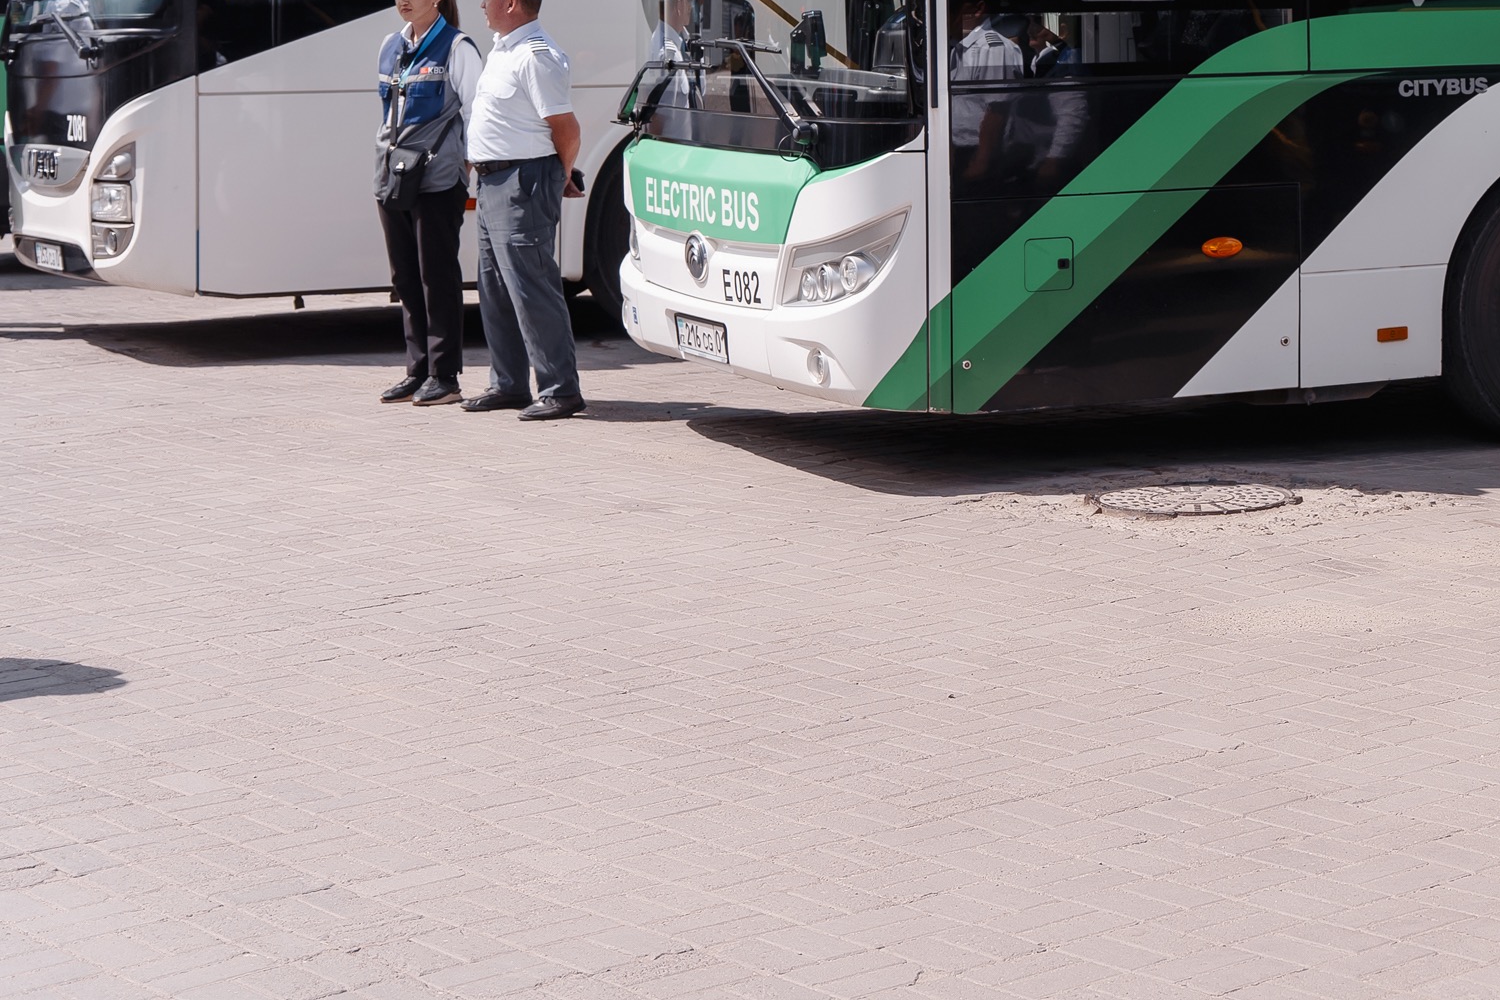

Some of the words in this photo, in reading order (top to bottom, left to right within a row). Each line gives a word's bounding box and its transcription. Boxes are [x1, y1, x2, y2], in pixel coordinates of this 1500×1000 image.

[1398, 77, 1489, 98] CITYBUS
[66, 114, 88, 143] Z081
[645, 176, 717, 225] ELECTRIC
[721, 188, 760, 232] BUS
[685, 322, 702, 348] 216
